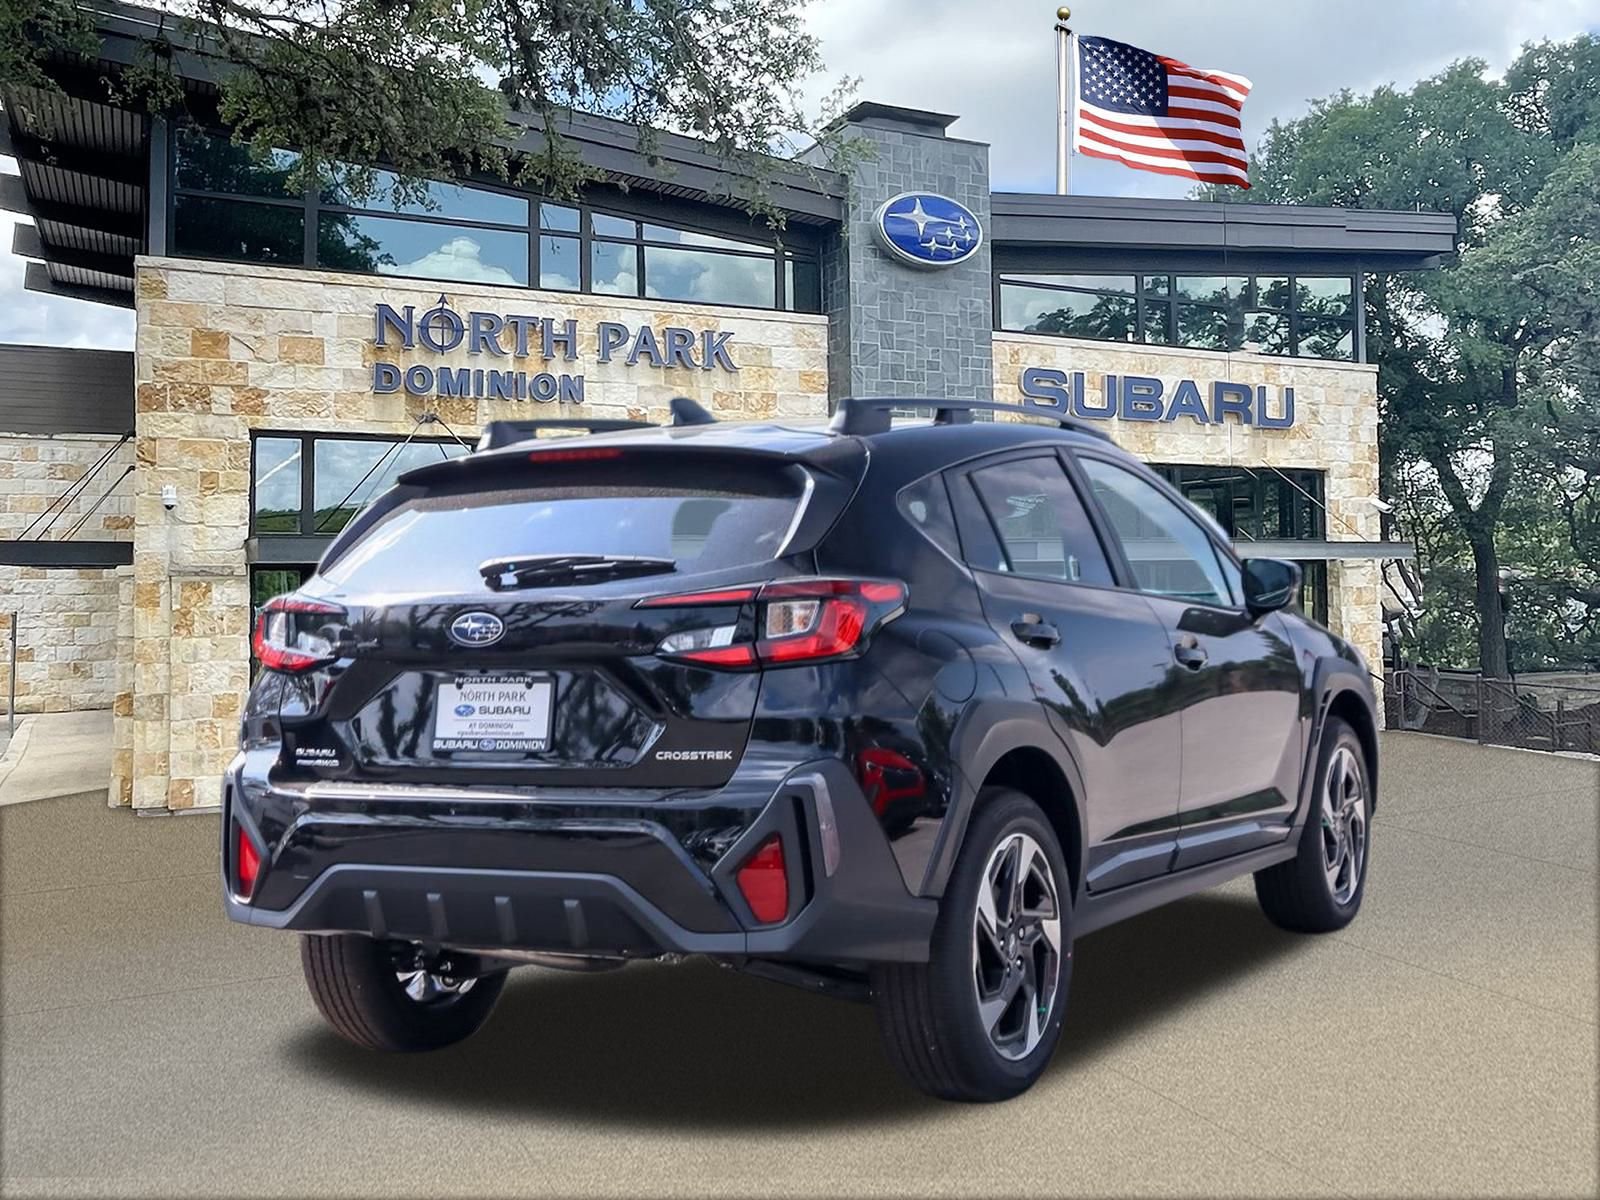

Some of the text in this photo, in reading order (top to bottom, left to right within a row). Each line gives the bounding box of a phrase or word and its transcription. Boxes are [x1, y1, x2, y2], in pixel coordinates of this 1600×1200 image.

[374, 293, 740, 373] NORTH PARK
[373, 362, 585, 404] DOMINION
[1018, 367, 1295, 430] SUBARU
[455, 676, 533, 684] NORTH PARK
[459, 690, 527, 702] NORTH PARK
[479, 705, 531, 715] SUBARU
[478, 721, 514, 729] DOMINION
[433, 739, 546, 750] SUBARU DOMINION
[655, 750, 733, 760] CROSSTREK
